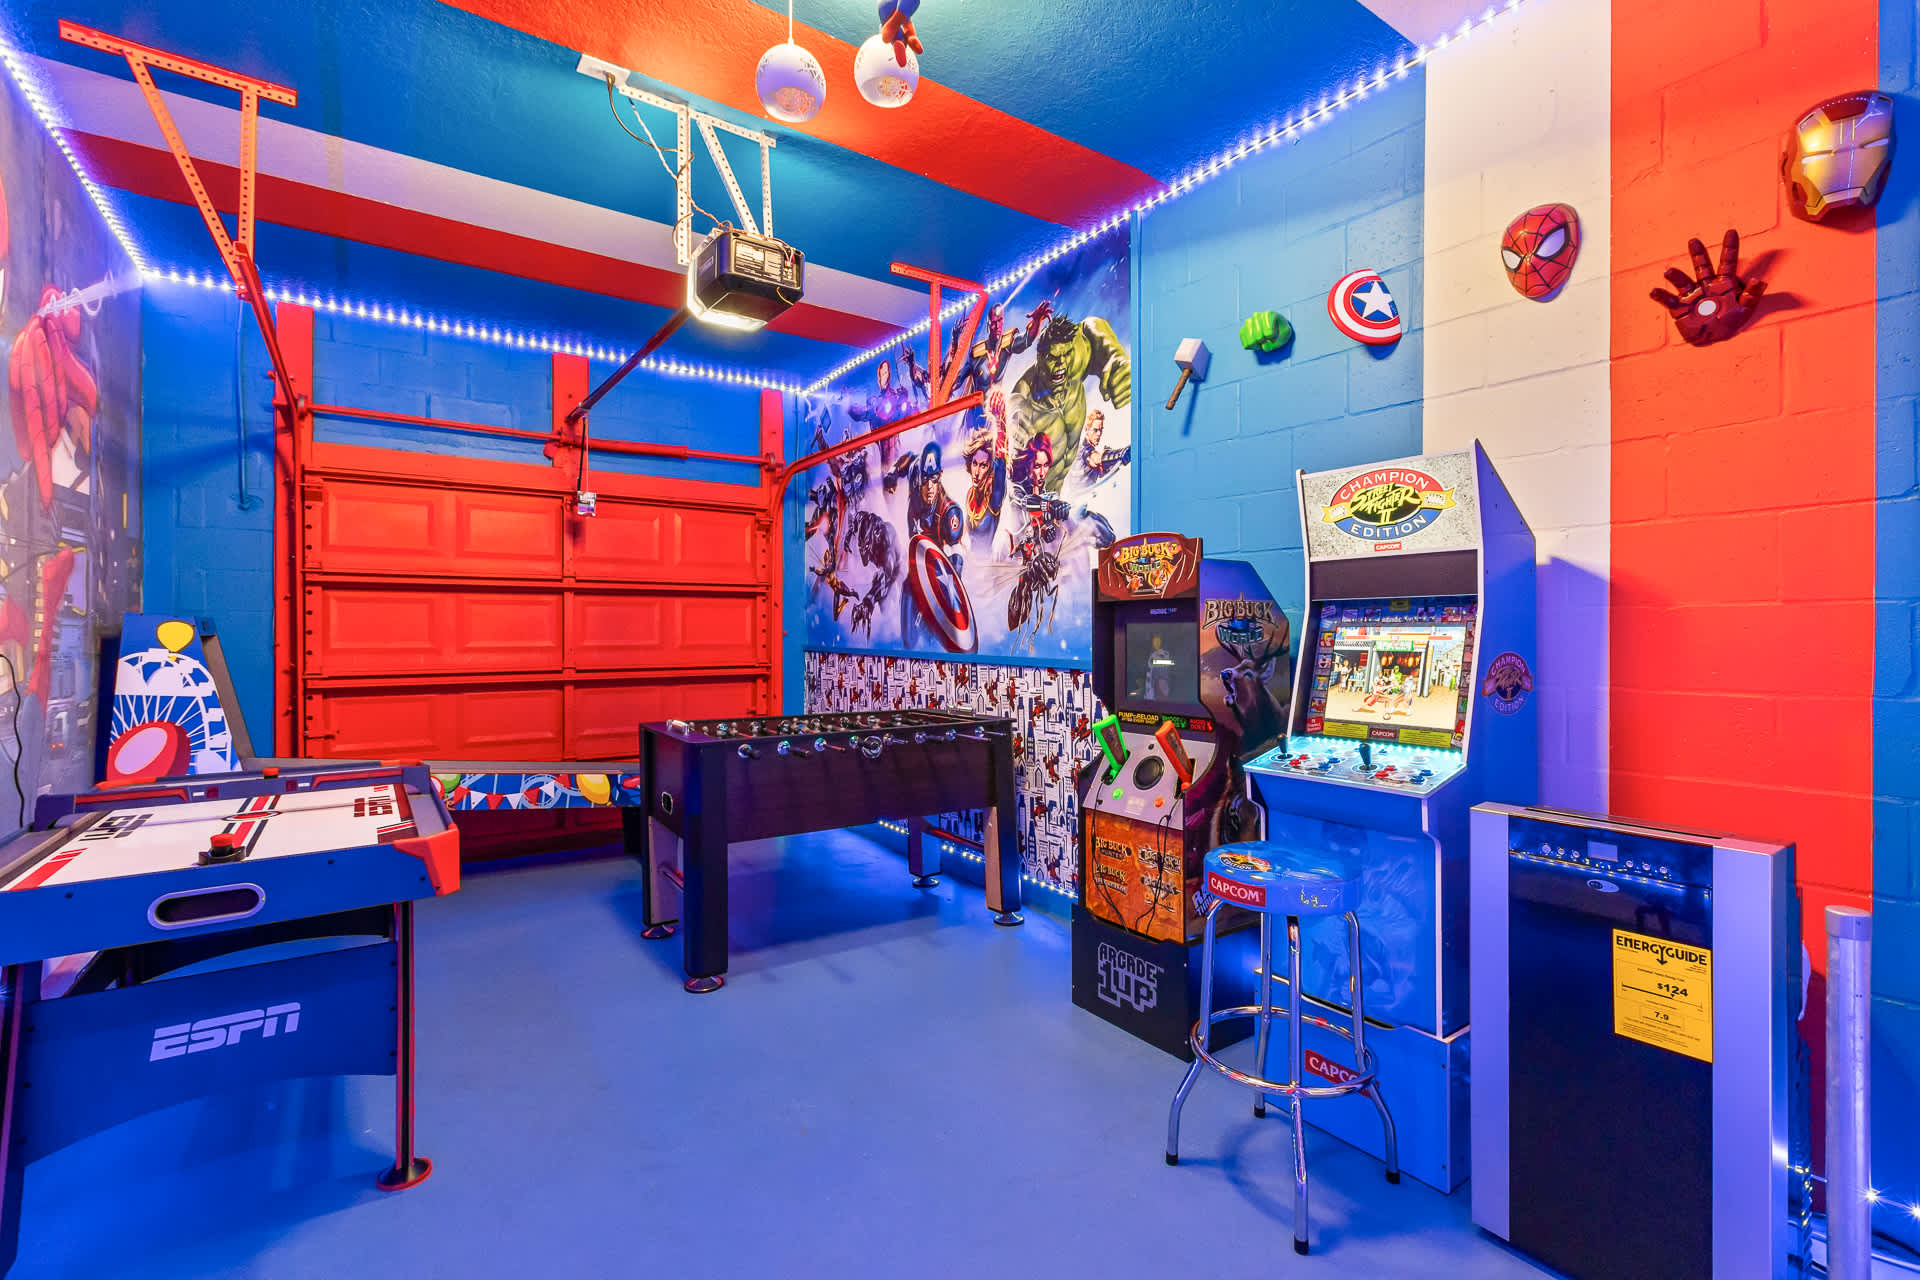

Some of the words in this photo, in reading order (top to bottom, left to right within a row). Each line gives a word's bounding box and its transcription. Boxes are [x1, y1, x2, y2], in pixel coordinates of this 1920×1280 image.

[1340, 471, 1429, 500] CHAMPION
[1350, 515, 1427, 538] EDITION
[1376, 507, 1397, 526] II
[1121, 546, 1140, 562] BIG
[1140, 541, 1171, 557] BUCK
[1204, 599, 1234, 623] BIG
[1236, 600, 1274, 621] BUCK
[1219, 627, 1264, 643] WORLD
[1491, 655, 1526, 676] CHAMPION
[1494, 697, 1524, 712] EDITION
[1211, 877, 1260, 903] CAPCOM
[1616, 935, 1708, 966] ENERGYGUIDE
[1657, 982, 1689, 998] $124
[1654, 1010, 1670, 1021] 7.9
[149, 1001, 301, 1063] ESPN
[1308, 1055, 1360, 1084] CAPCO
